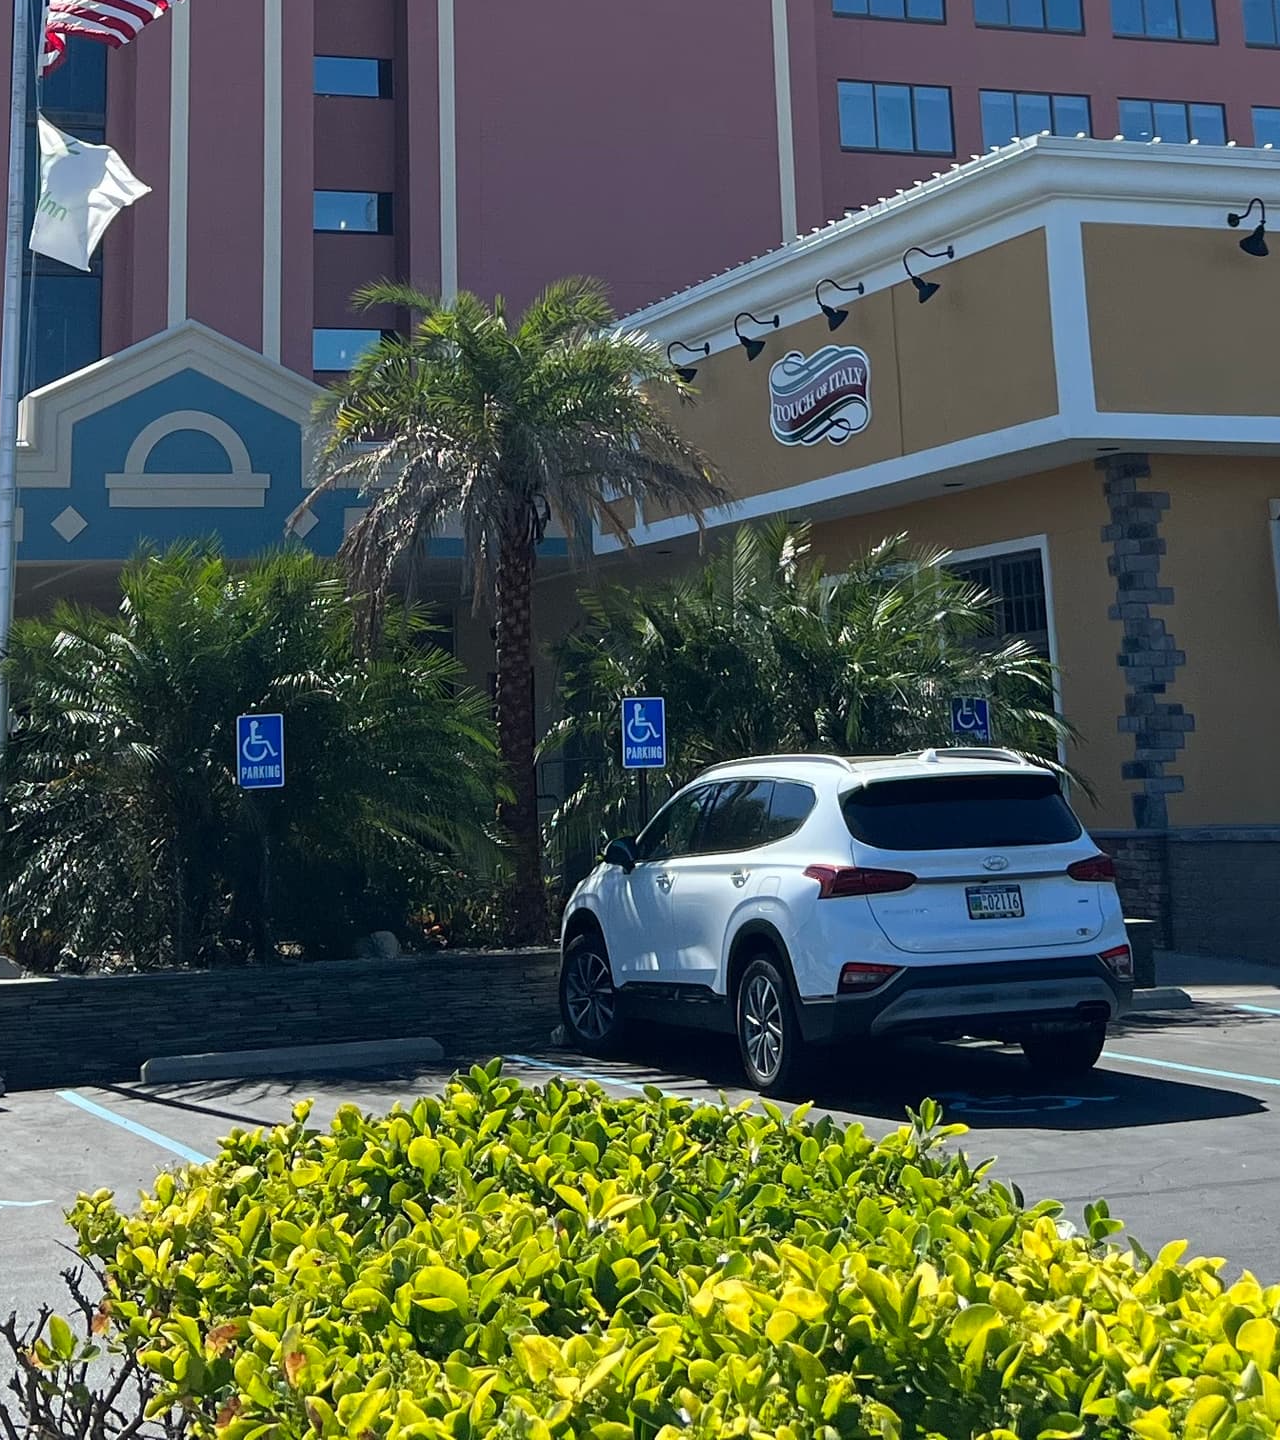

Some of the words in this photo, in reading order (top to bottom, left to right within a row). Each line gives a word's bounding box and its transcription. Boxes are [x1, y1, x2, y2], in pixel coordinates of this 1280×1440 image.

[39, 191, 67, 222] Inn
[774, 390, 816, 422] TOUCH
[829, 366, 863, 394] ITALY
[625, 745, 663, 760] PARKING
[241, 764, 281, 780] PARKING
[987, 893, 1020, 911] 02116
